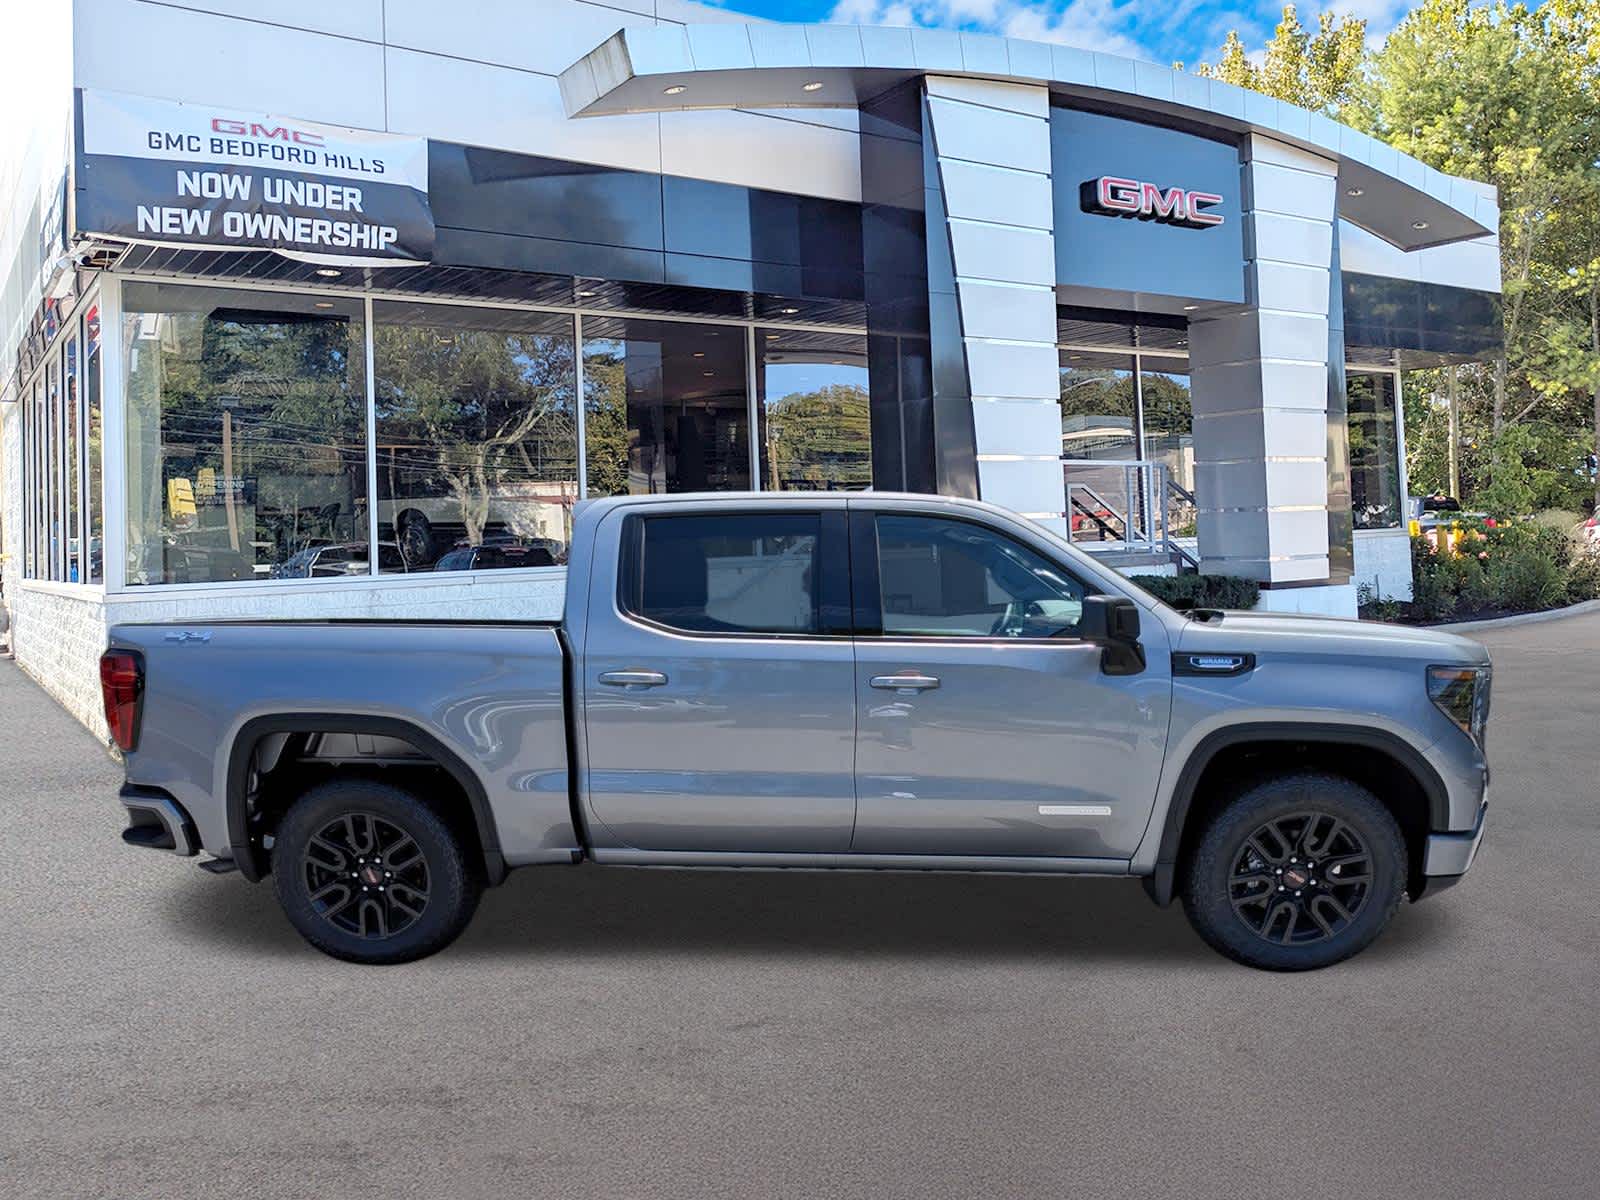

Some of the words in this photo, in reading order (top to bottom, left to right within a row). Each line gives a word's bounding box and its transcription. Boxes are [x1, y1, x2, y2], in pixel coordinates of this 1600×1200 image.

[148, 131, 201, 152] GMC
[210, 138, 316, 165] BEDFORD
[325, 153, 385, 174] HILLS
[211, 118, 325, 148] GMC
[177, 170, 252, 201] NOW
[263, 176, 364, 213] UNDER
[1097, 175, 1225, 224] GMC
[136, 205, 211, 236] NEW
[223, 210, 398, 250] OWNERSHIP
